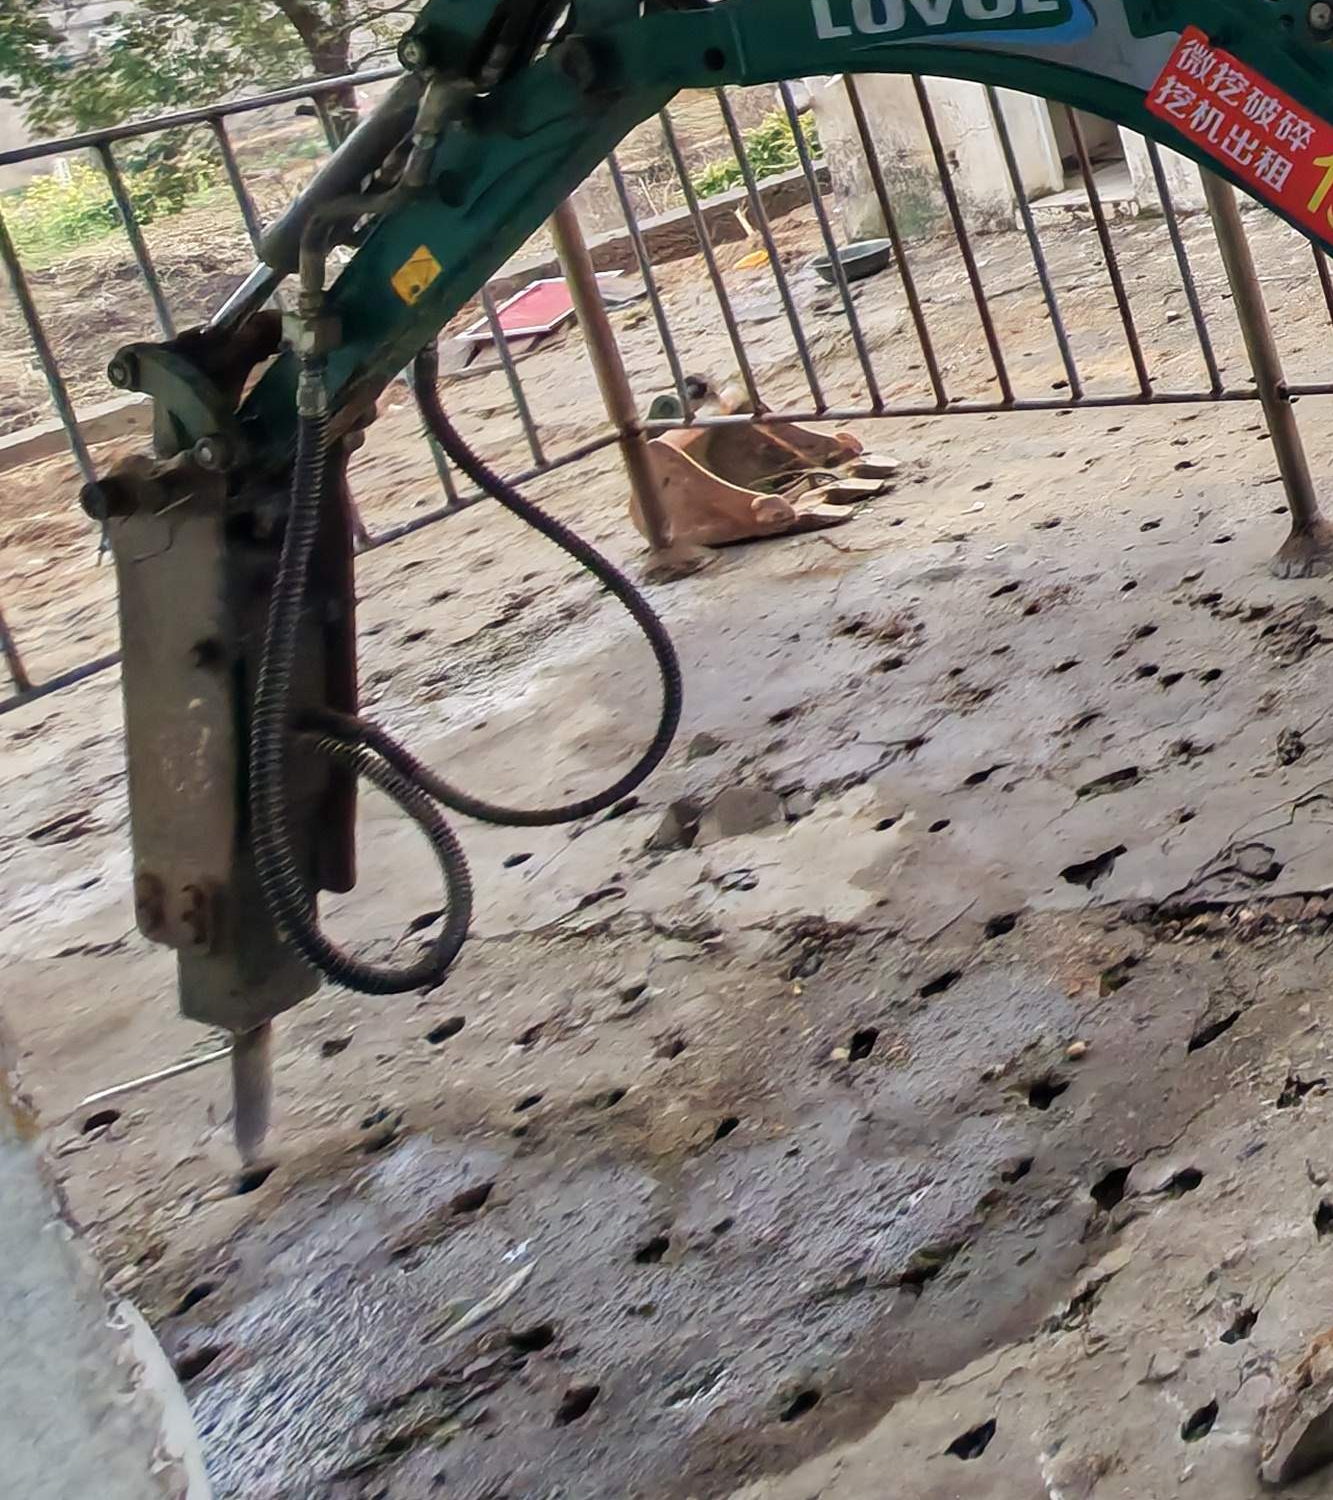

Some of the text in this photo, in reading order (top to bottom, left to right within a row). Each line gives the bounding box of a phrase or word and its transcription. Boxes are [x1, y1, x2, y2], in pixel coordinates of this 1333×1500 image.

[1155, 75, 1294, 192] 挖机出租
[1176, 39, 1316, 152] 微挖破碎
